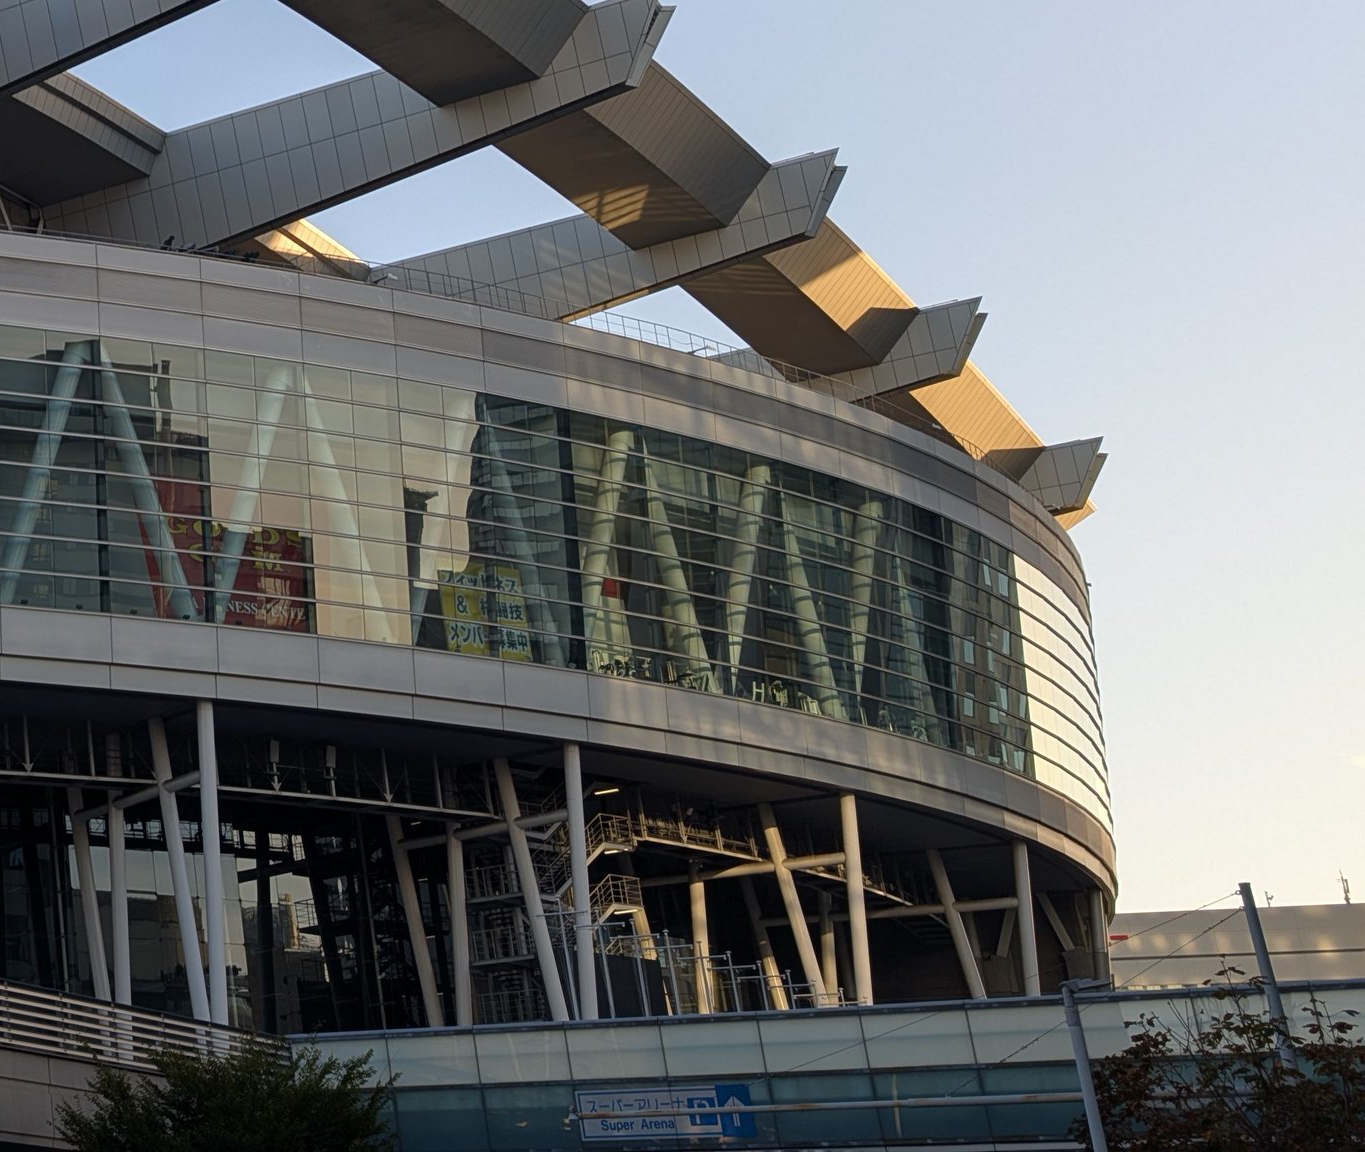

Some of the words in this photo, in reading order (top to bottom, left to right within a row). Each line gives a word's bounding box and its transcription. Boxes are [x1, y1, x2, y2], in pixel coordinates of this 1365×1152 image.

[457, 595, 468, 614] &
[601, 1119, 635, 1133] Super
[641, 1118, 675, 1131] Arena
